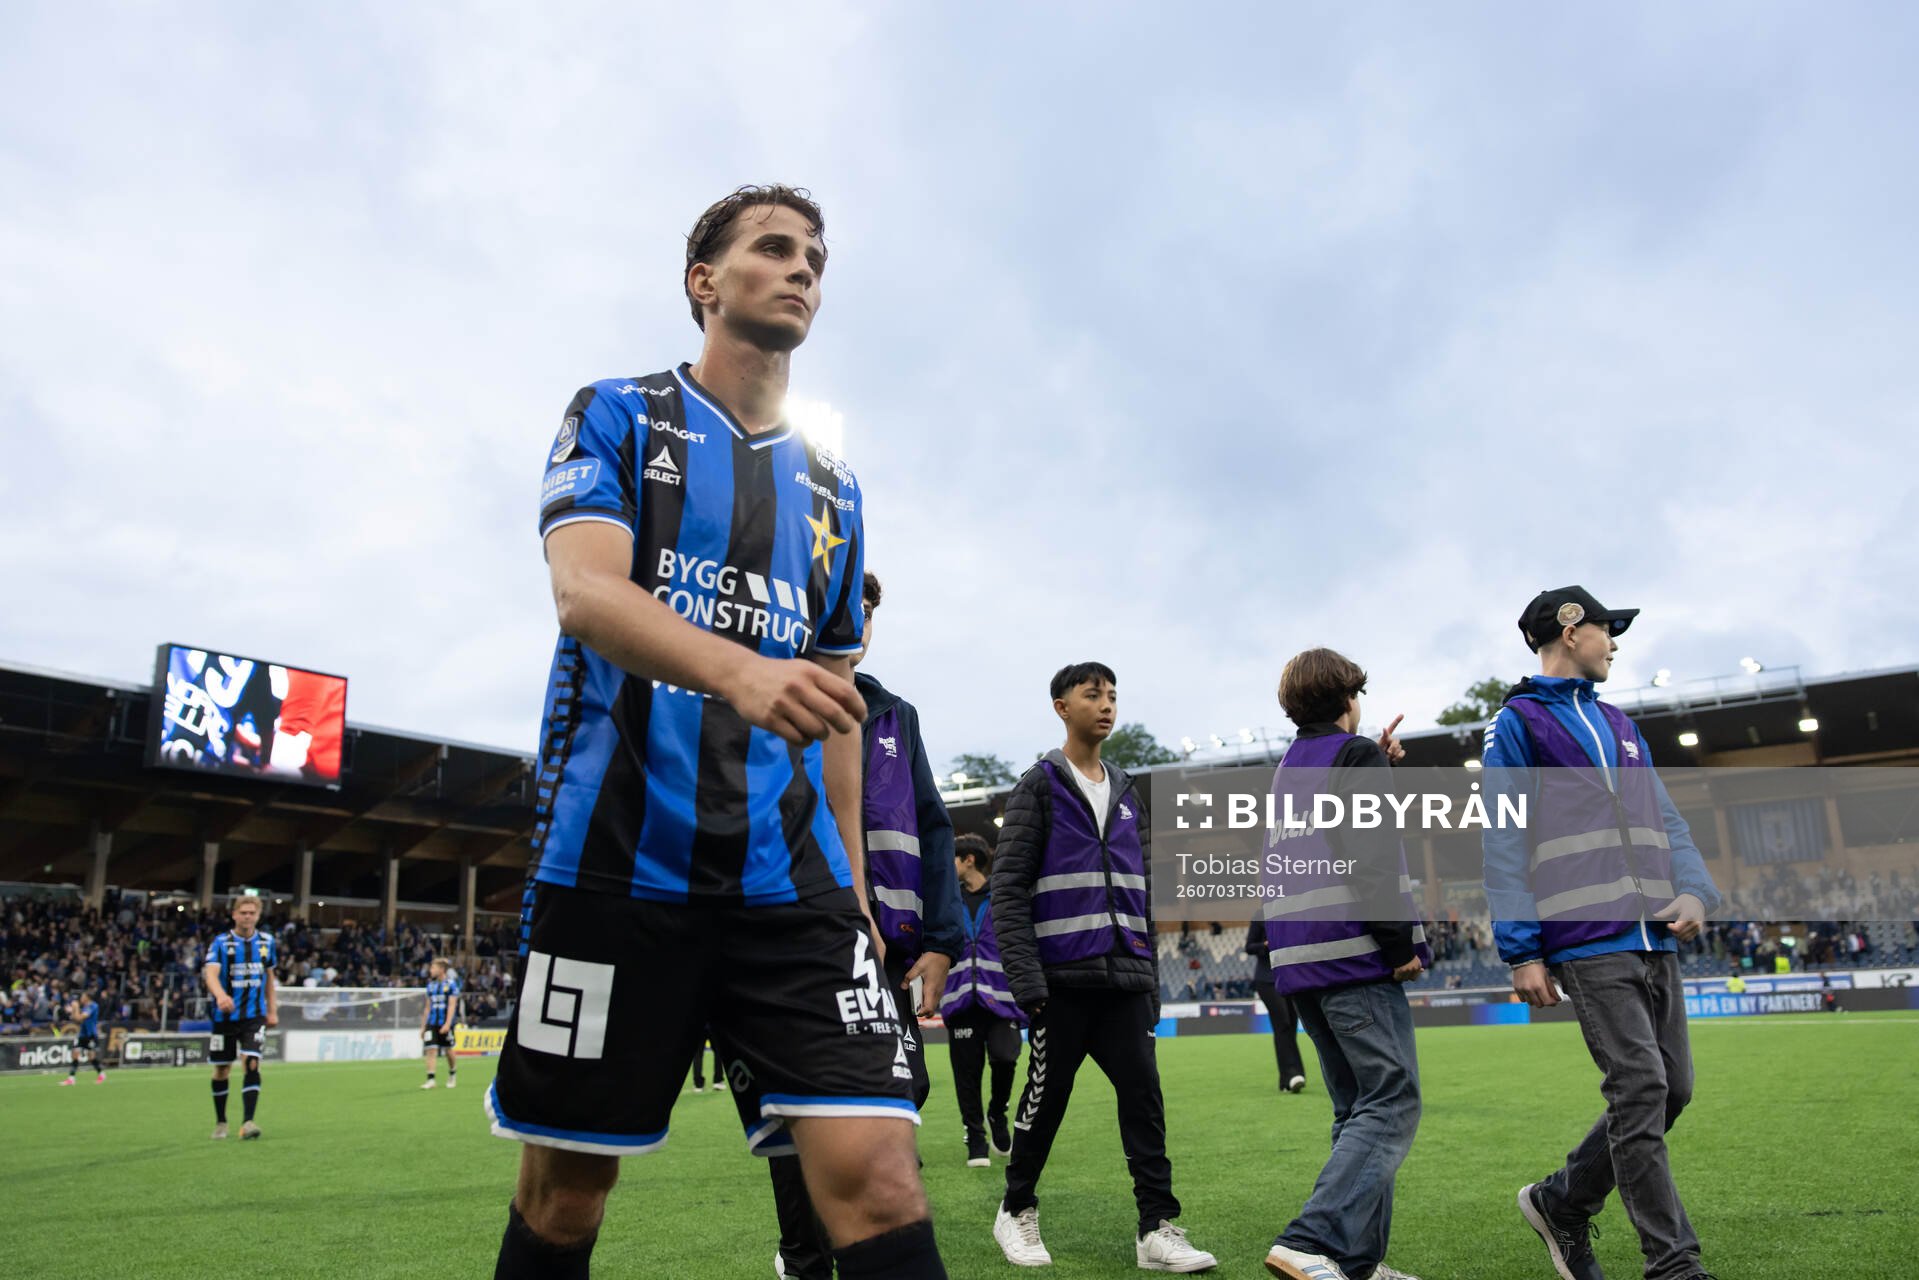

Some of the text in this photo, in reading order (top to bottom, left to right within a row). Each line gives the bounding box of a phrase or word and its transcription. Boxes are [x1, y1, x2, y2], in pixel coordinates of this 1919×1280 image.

[544, 465, 593, 491] NIBET
[643, 468, 681, 485] SELECT
[657, 548, 738, 595] BYGG
